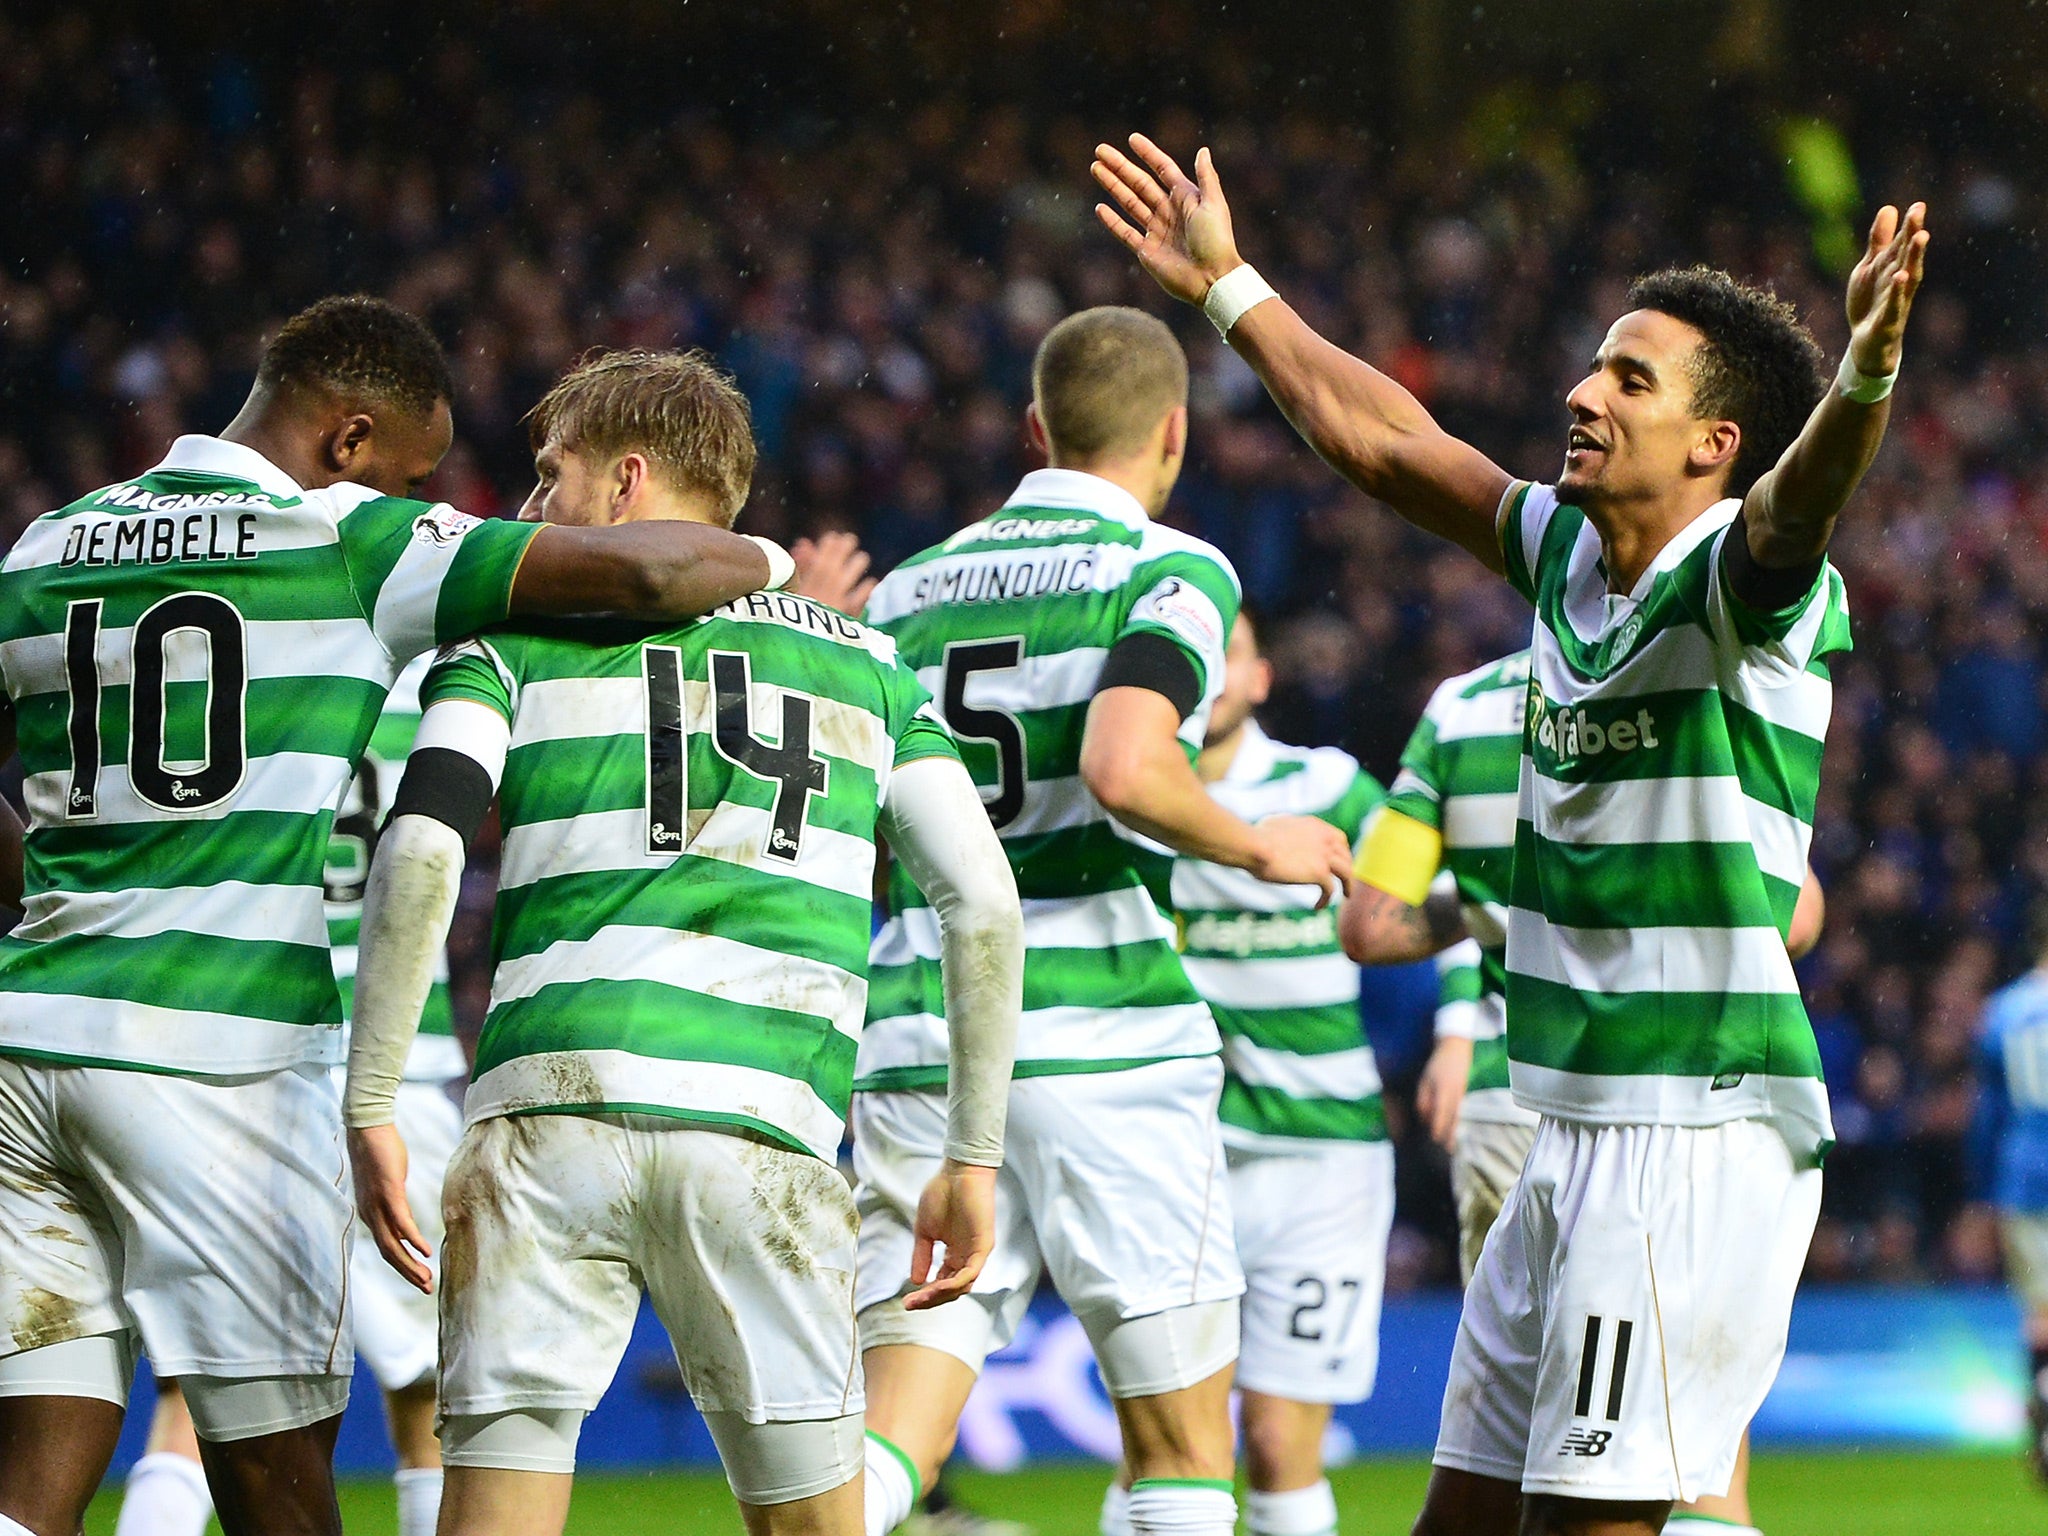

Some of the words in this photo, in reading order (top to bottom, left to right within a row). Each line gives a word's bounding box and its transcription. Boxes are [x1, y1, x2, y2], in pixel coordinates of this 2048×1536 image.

[59, 513, 259, 568] DEMBELE
[65, 591, 248, 819] 10
[942, 634, 1029, 832] 5
[641, 643, 829, 866] 14
[76, 793, 93, 804] SPFL
[177, 788, 202, 798] SPFL
[657, 831, 682, 842] SPFL
[778, 837, 798, 851] SPFL
[1290, 1276, 1359, 1344] 27
[1573, 1313, 1635, 1424] 11
